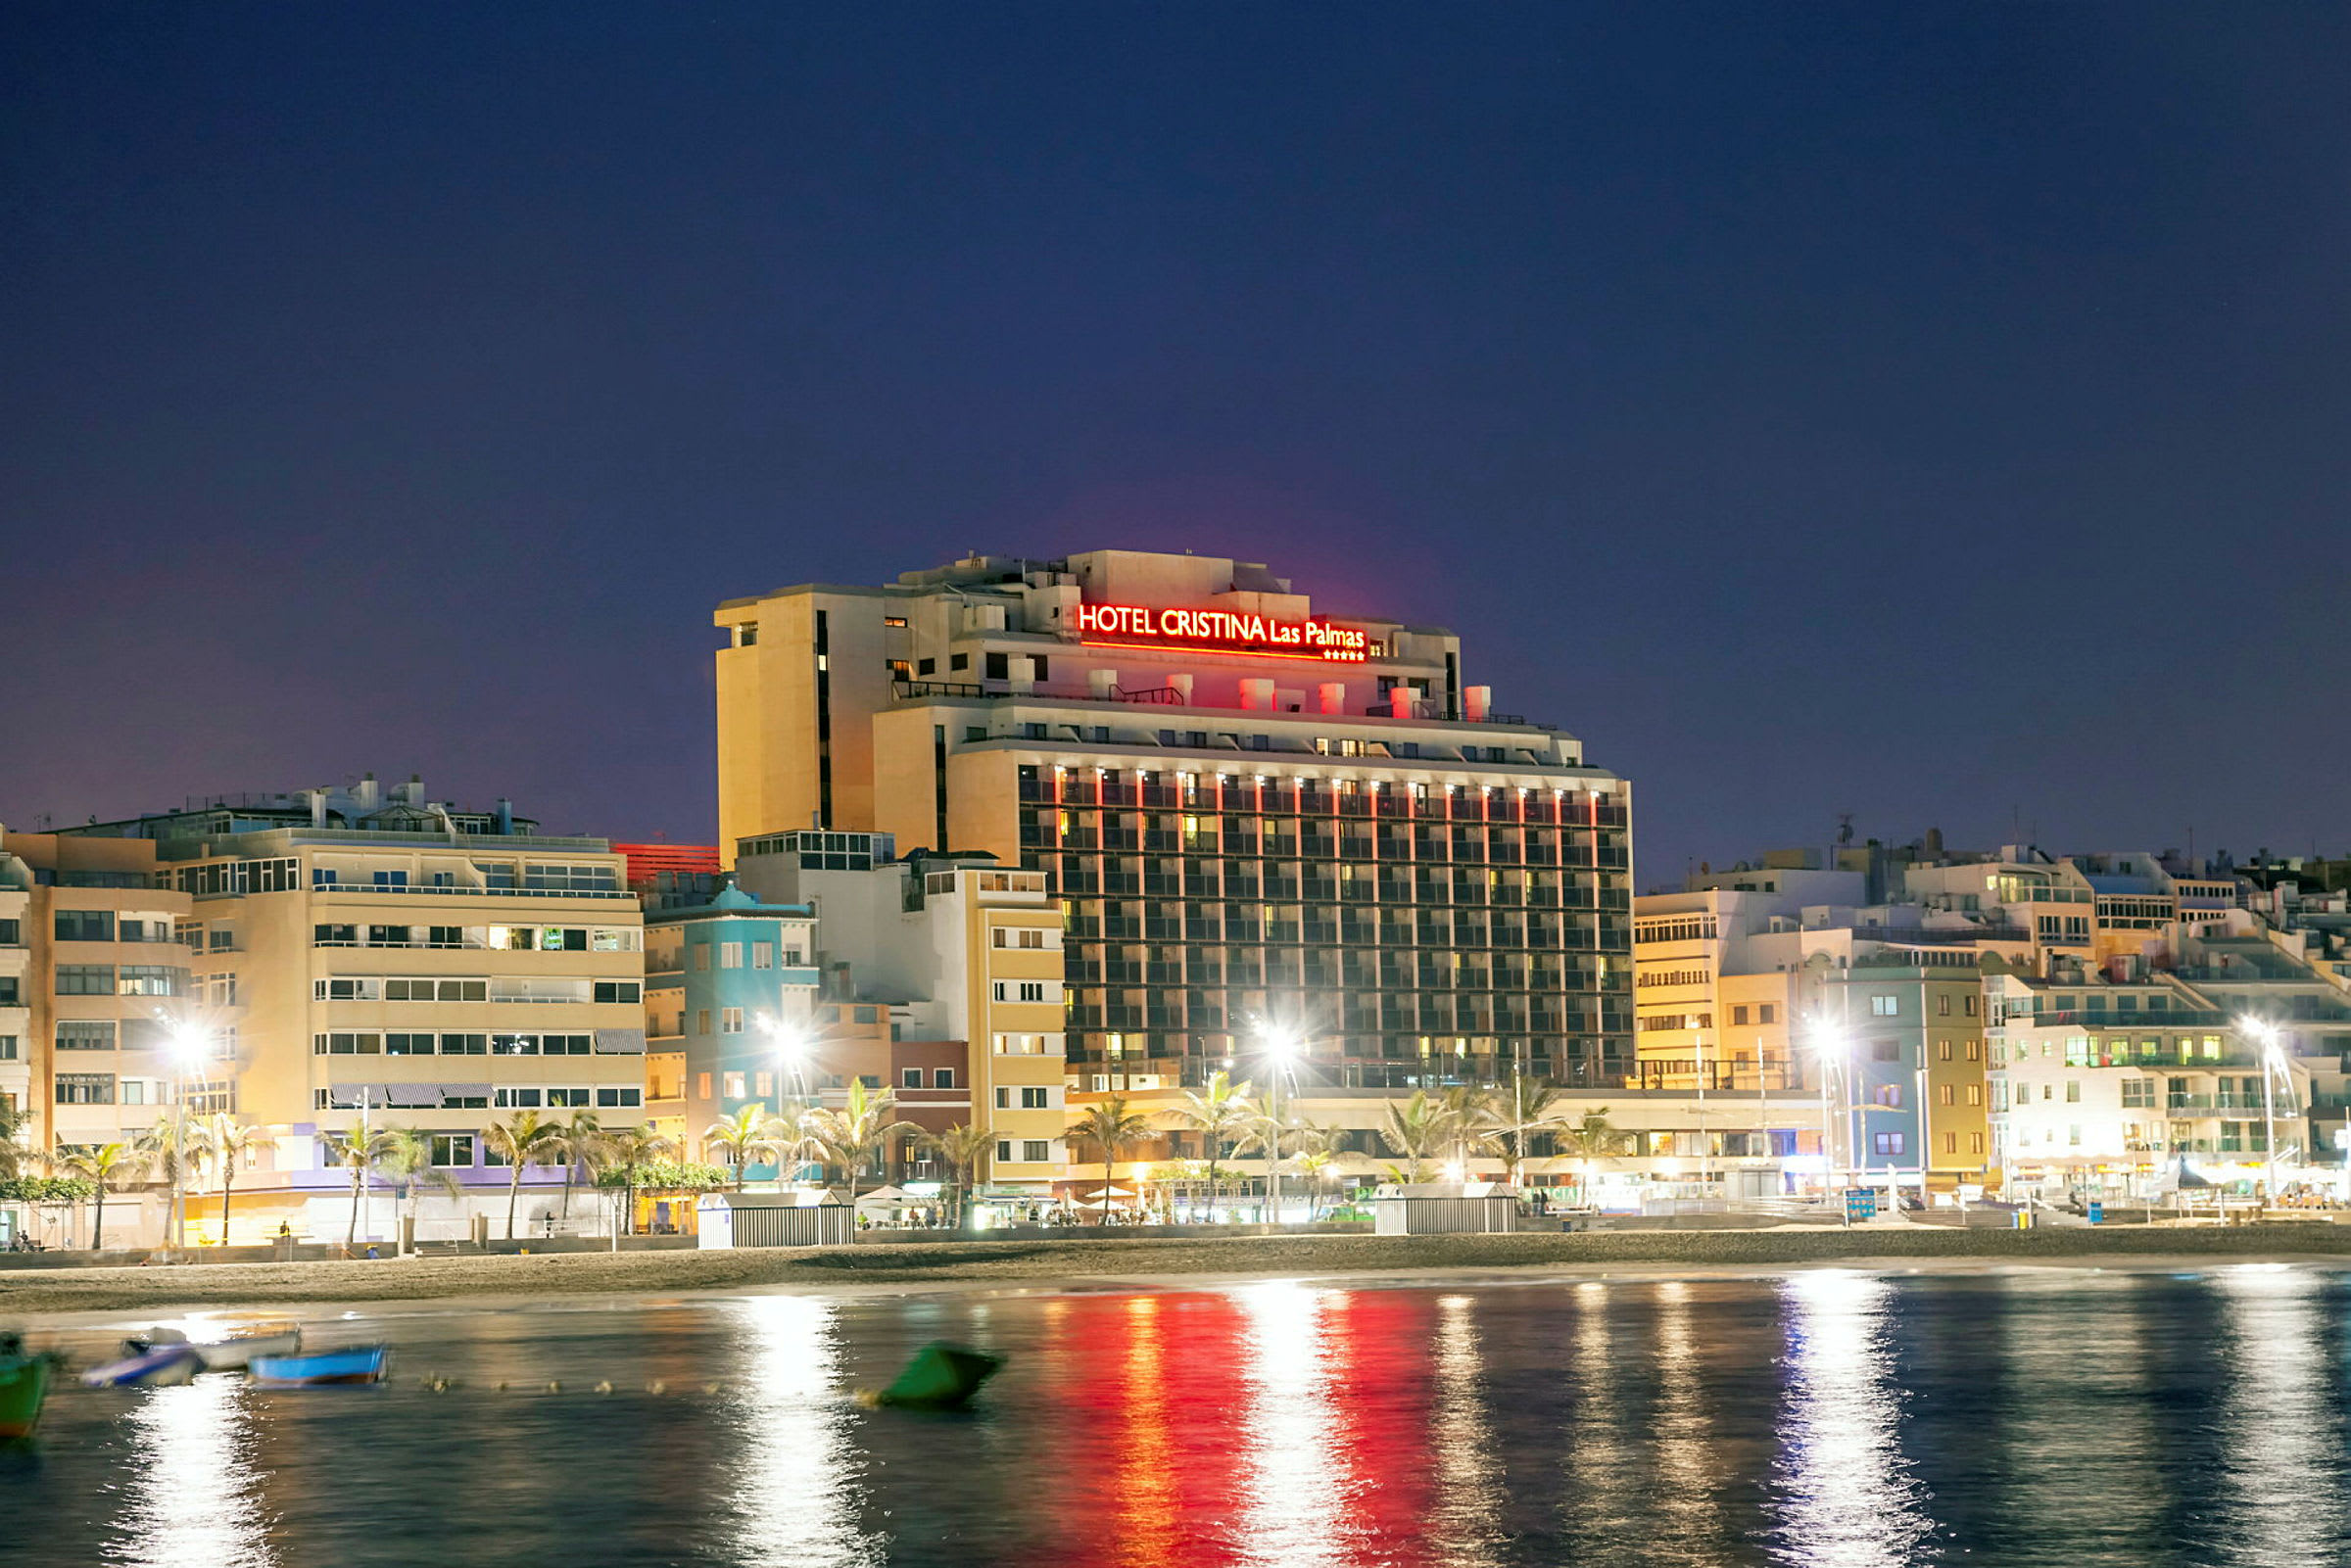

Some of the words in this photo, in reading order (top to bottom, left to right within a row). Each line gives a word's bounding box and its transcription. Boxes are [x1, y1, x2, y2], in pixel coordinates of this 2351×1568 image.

[1079, 604, 1157, 635] HOTEL
[1160, 608, 1268, 641] CRISTINA
[1270, 619, 1300, 643] Las
[1305, 621, 1365, 647] Palmas
